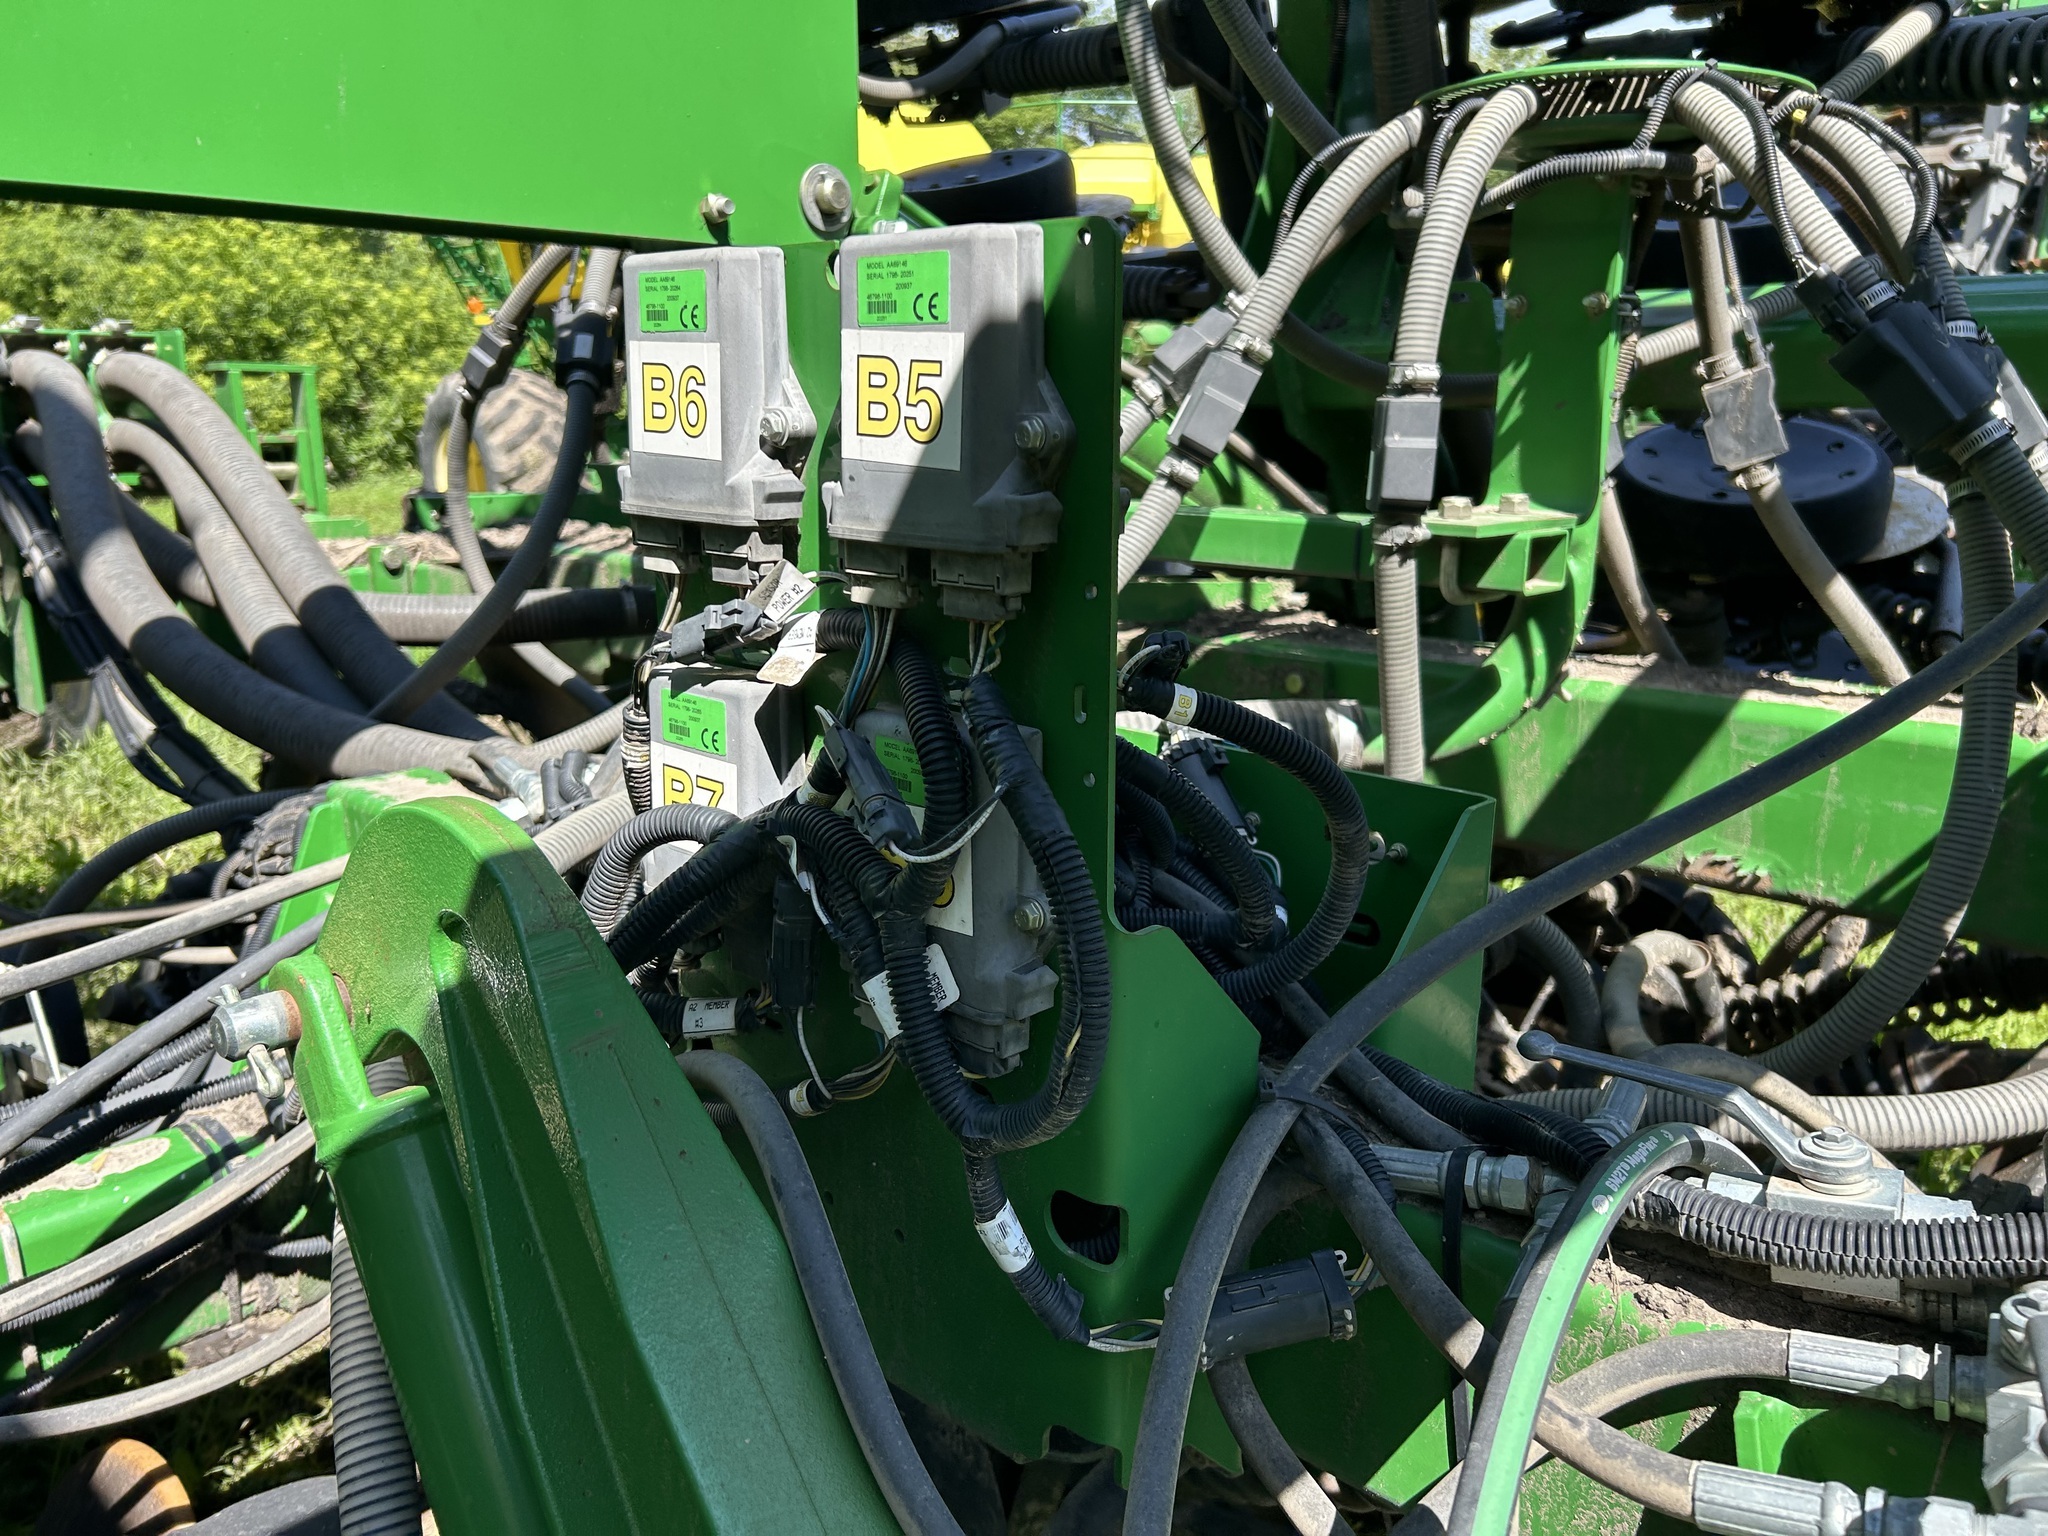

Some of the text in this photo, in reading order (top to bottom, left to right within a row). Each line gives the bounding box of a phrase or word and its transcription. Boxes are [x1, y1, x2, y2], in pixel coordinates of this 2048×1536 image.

[866, 261, 884, 269] MODEL
[866, 272, 884, 280] SERIAL
[642, 362, 707, 438] B6
[857, 354, 943, 444] B5
[771, 583, 804, 613] POWER #2
[1174, 694, 1192, 717] B1
[884, 741, 900, 751] MODEL
[883, 750, 900, 760] SERIAL
[930, 972, 947, 1003] MEMBER
[704, 1000, 730, 1010] MEMBER
